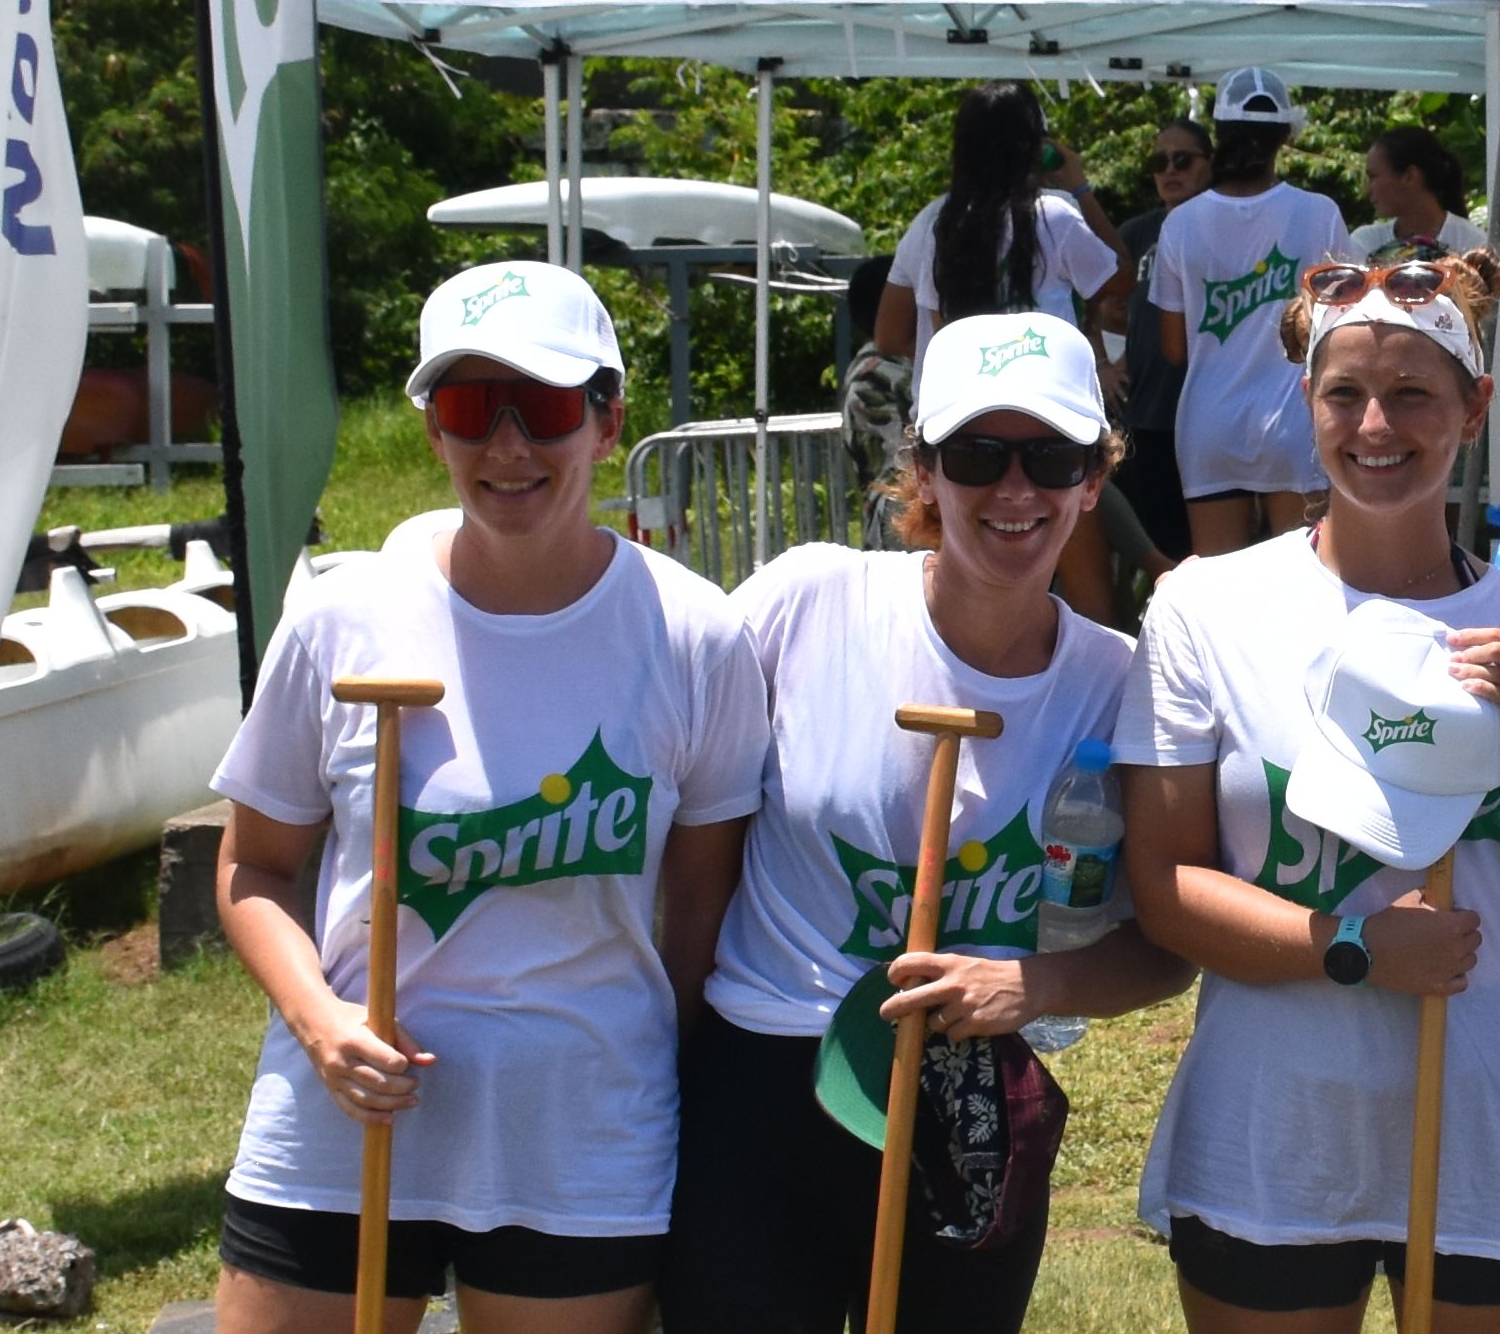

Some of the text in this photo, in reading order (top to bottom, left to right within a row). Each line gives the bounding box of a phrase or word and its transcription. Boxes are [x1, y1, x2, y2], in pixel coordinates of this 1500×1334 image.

[1209, 261, 1294, 329] Sprite
[984, 334, 1042, 373] Sprite
[1367, 715, 1432, 745] Sprite
[408, 774, 638, 895] Sprite
[856, 840, 1043, 948] Site
